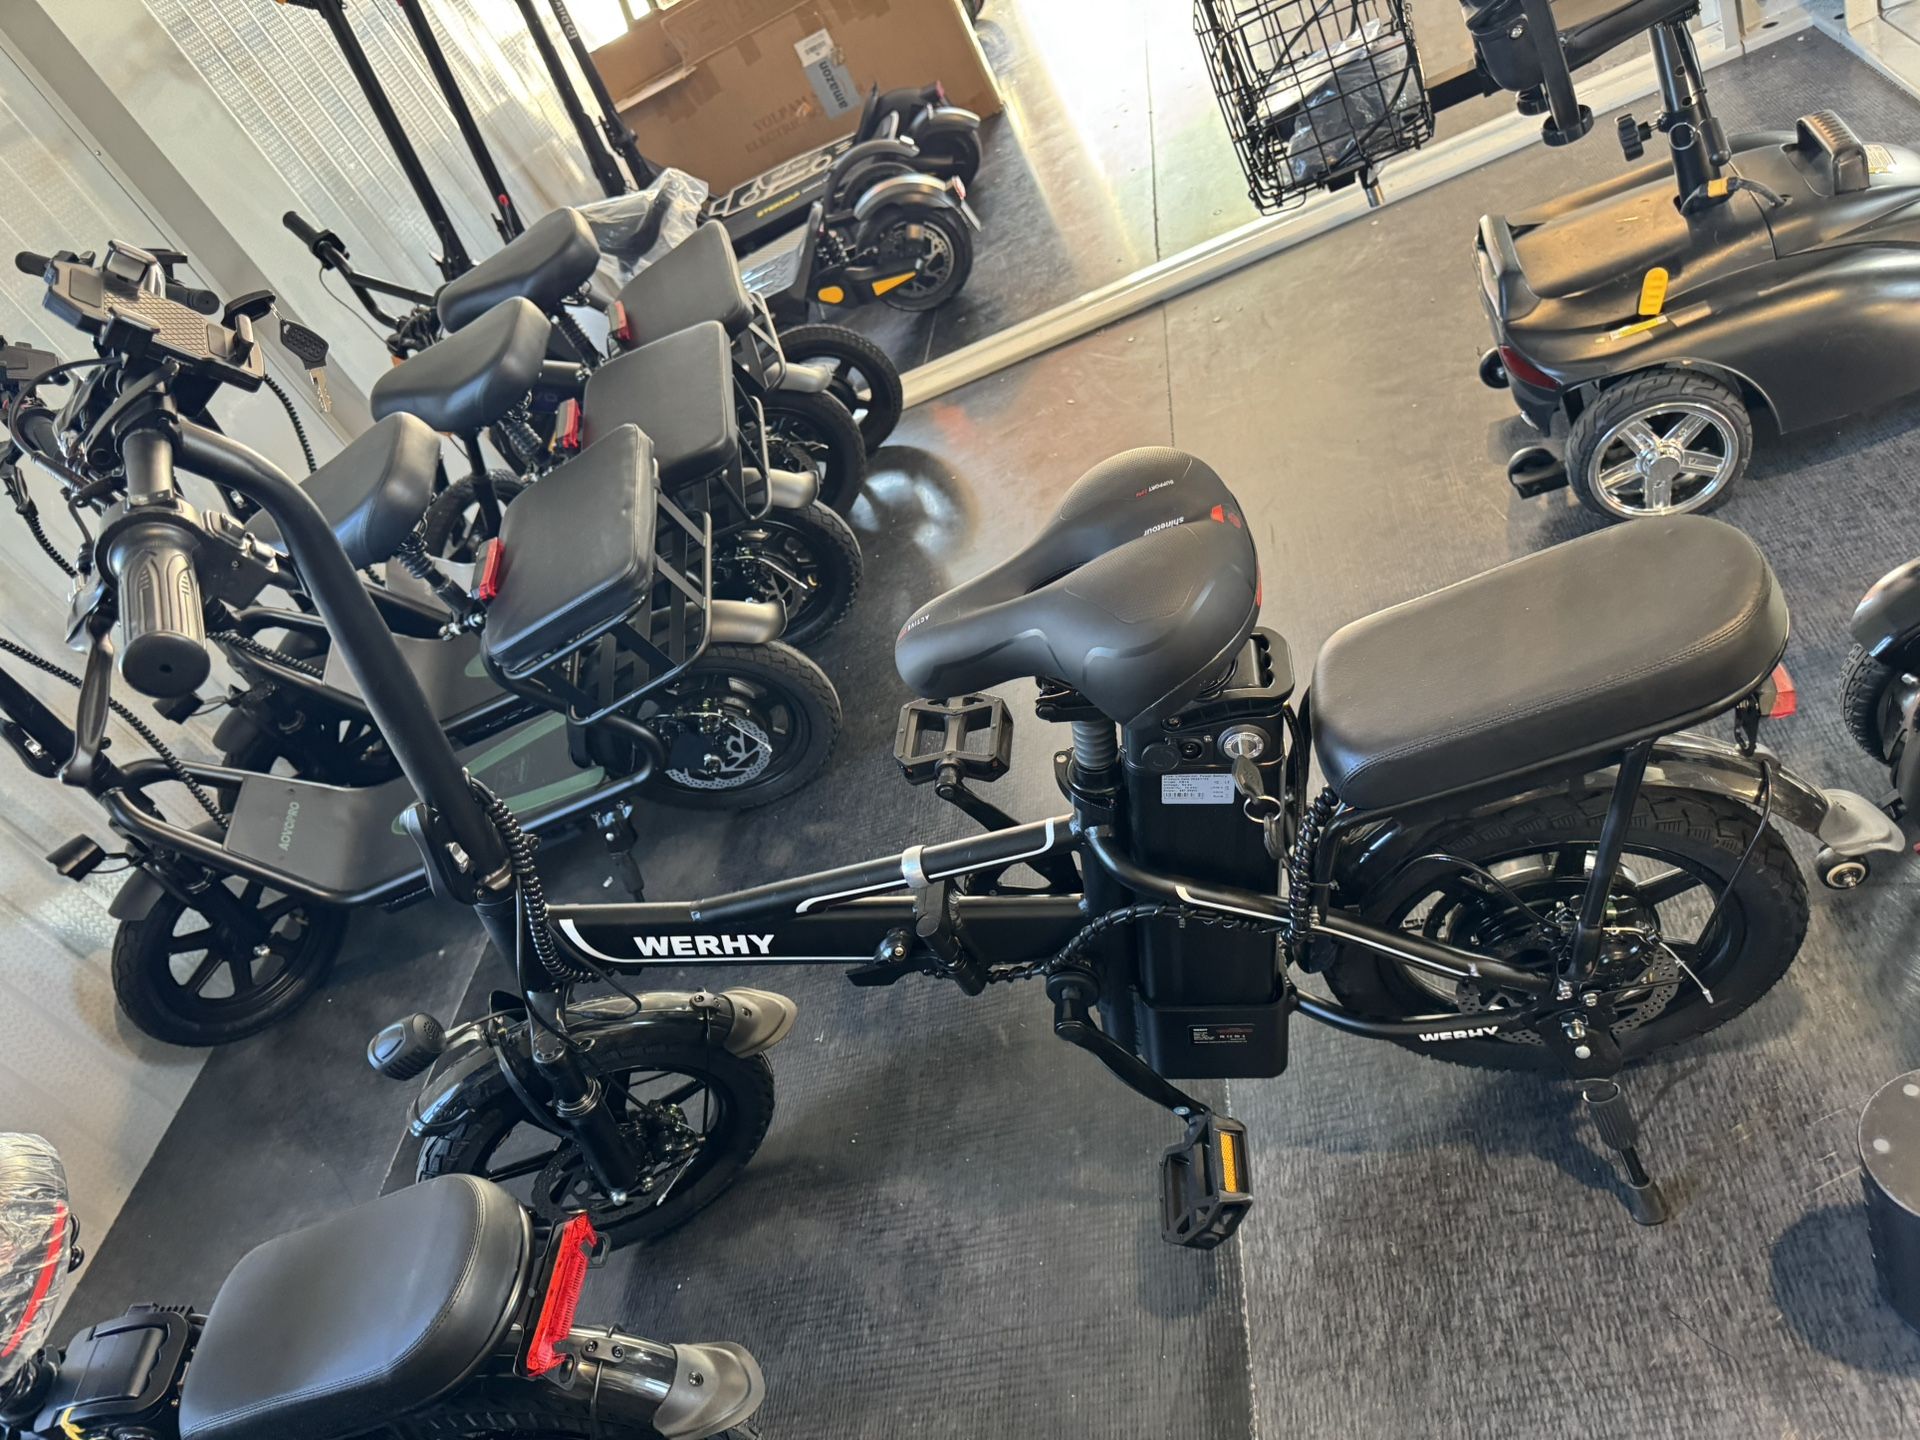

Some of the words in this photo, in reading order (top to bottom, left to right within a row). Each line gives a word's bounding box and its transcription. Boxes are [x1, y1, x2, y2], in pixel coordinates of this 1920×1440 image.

[818, 60, 849, 109] amazon
[1143, 516, 1184, 537] shinetour
[633, 934, 775, 957] WERHY
[1418, 1025, 1499, 1042] WERHY
